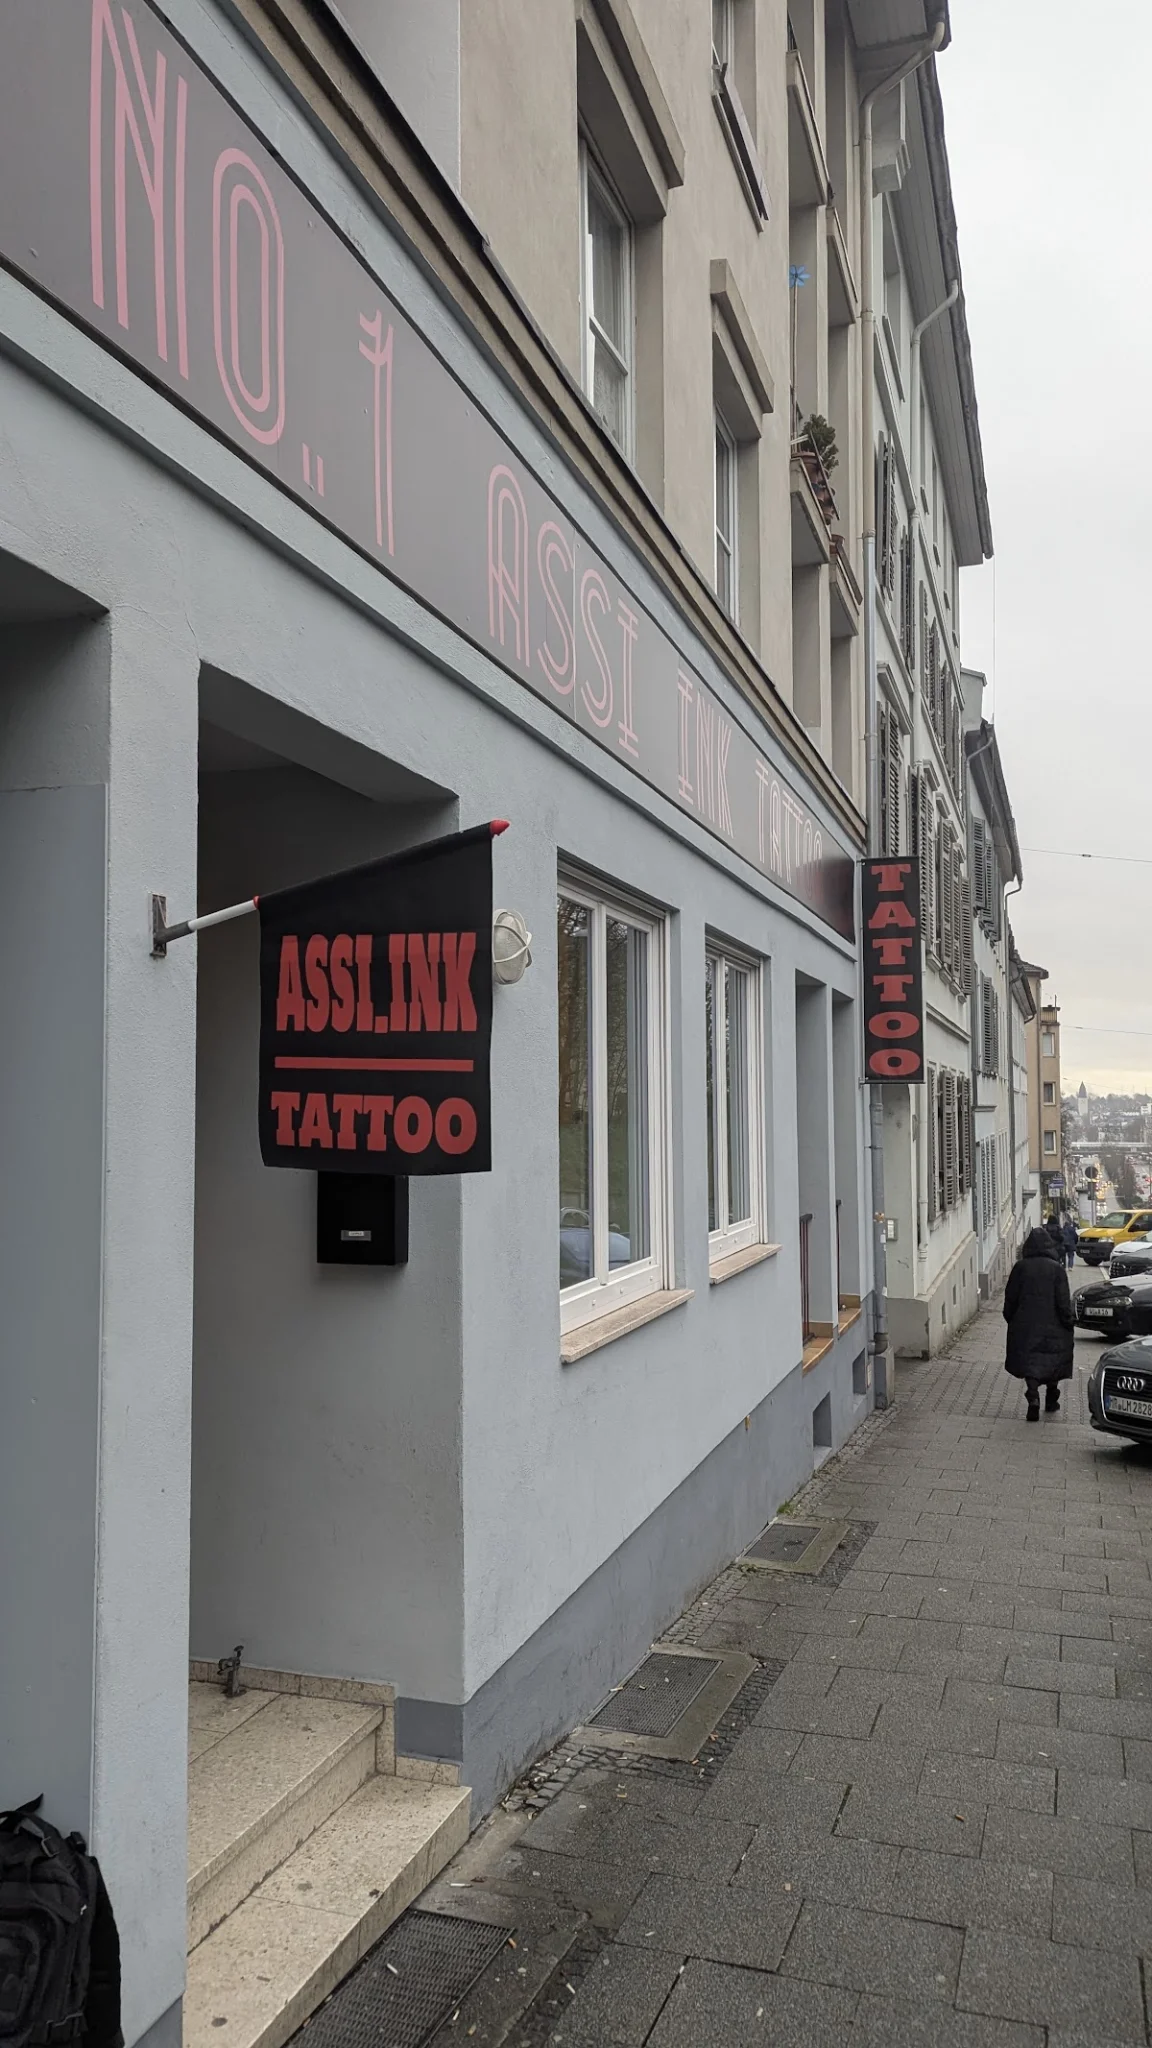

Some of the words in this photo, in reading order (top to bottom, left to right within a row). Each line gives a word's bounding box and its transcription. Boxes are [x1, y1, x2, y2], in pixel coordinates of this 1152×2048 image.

[358, 309, 394, 557] 1
[487, 464, 639, 758] ASSI
[677, 668, 734, 839] INK
[755, 758, 824, 903] TATTOO
[275, 931, 478, 1034] ASSI.INK
[868, 864, 920, 1076] TATTOO
[270, 1090, 478, 1156] TATTOO
